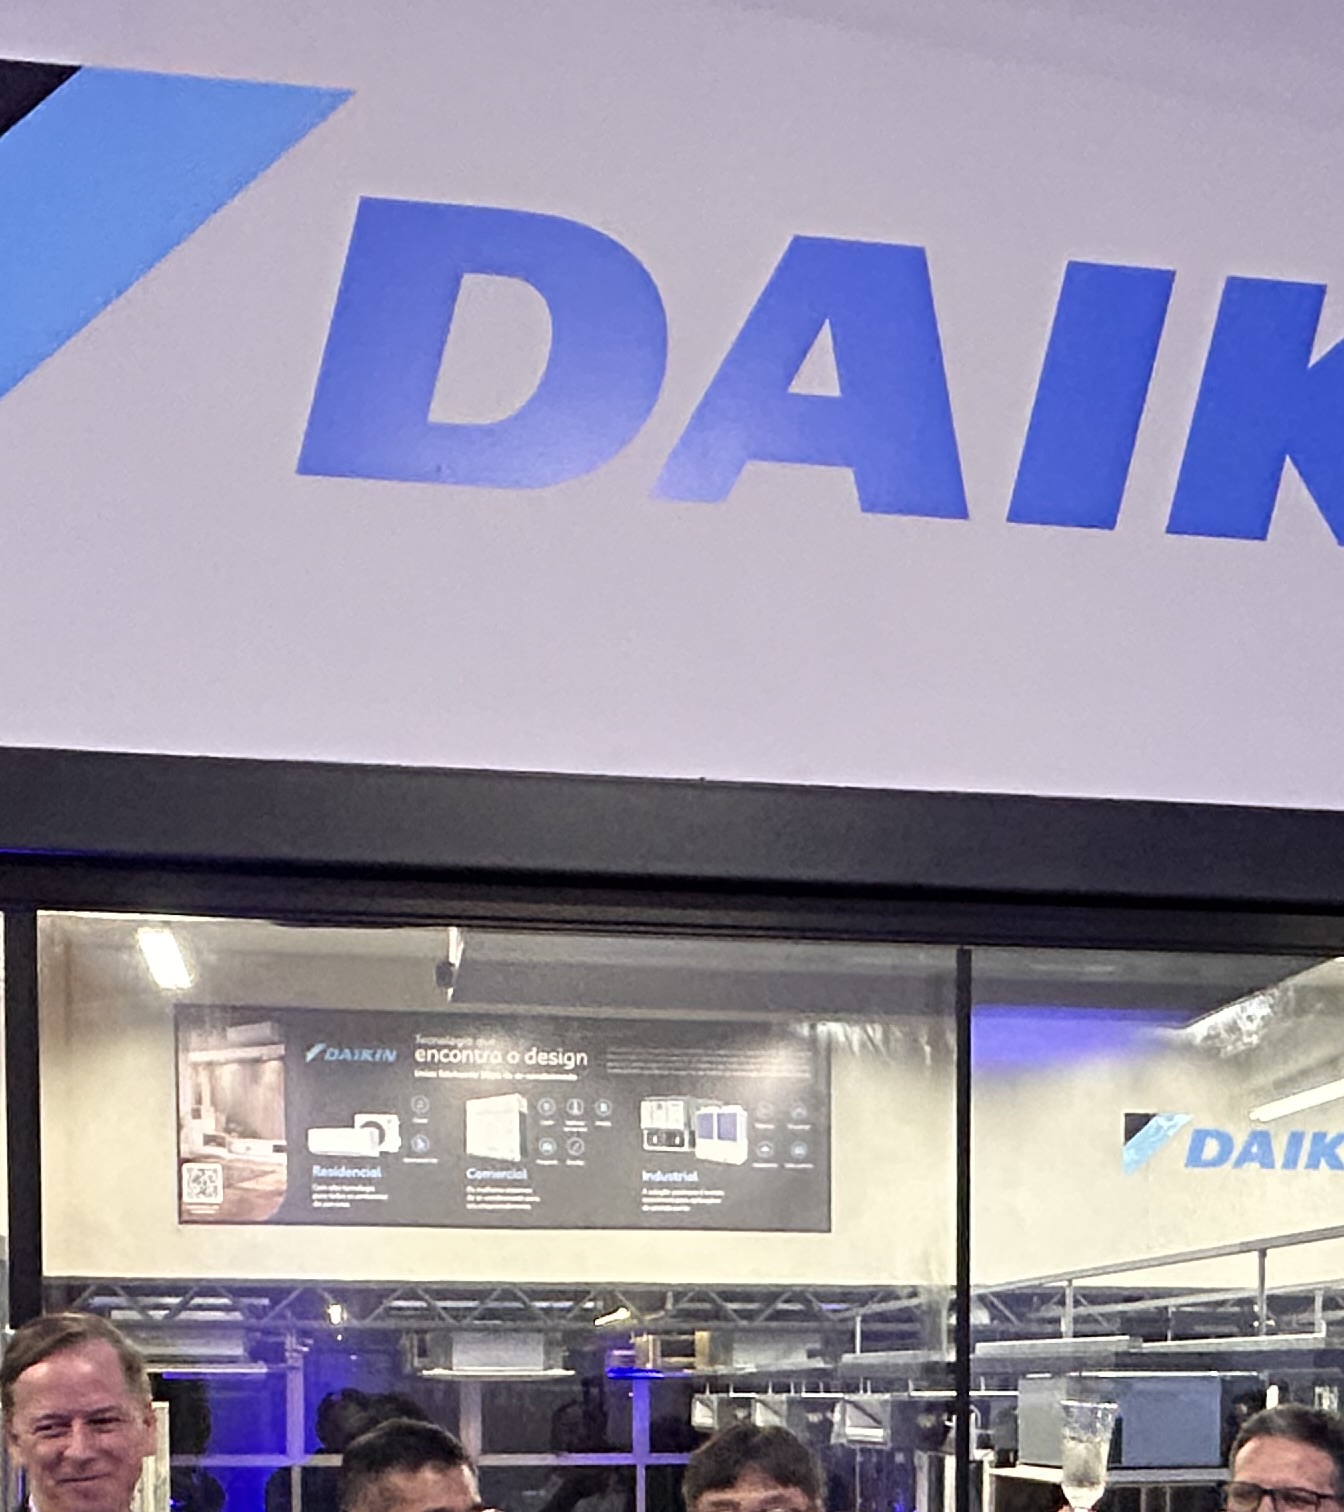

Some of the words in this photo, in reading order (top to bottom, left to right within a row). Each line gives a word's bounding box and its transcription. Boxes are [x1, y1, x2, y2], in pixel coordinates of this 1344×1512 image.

[324, 1047, 397, 1062] DAIKIN
[414, 1047, 502, 1065] encontra
[506, 1050, 520, 1064] o
[524, 1047, 588, 1069] design
[312, 1164, 382, 1178] Residencial
[466, 1167, 528, 1180] Comercial
[642, 1169, 699, 1182] Industrial
